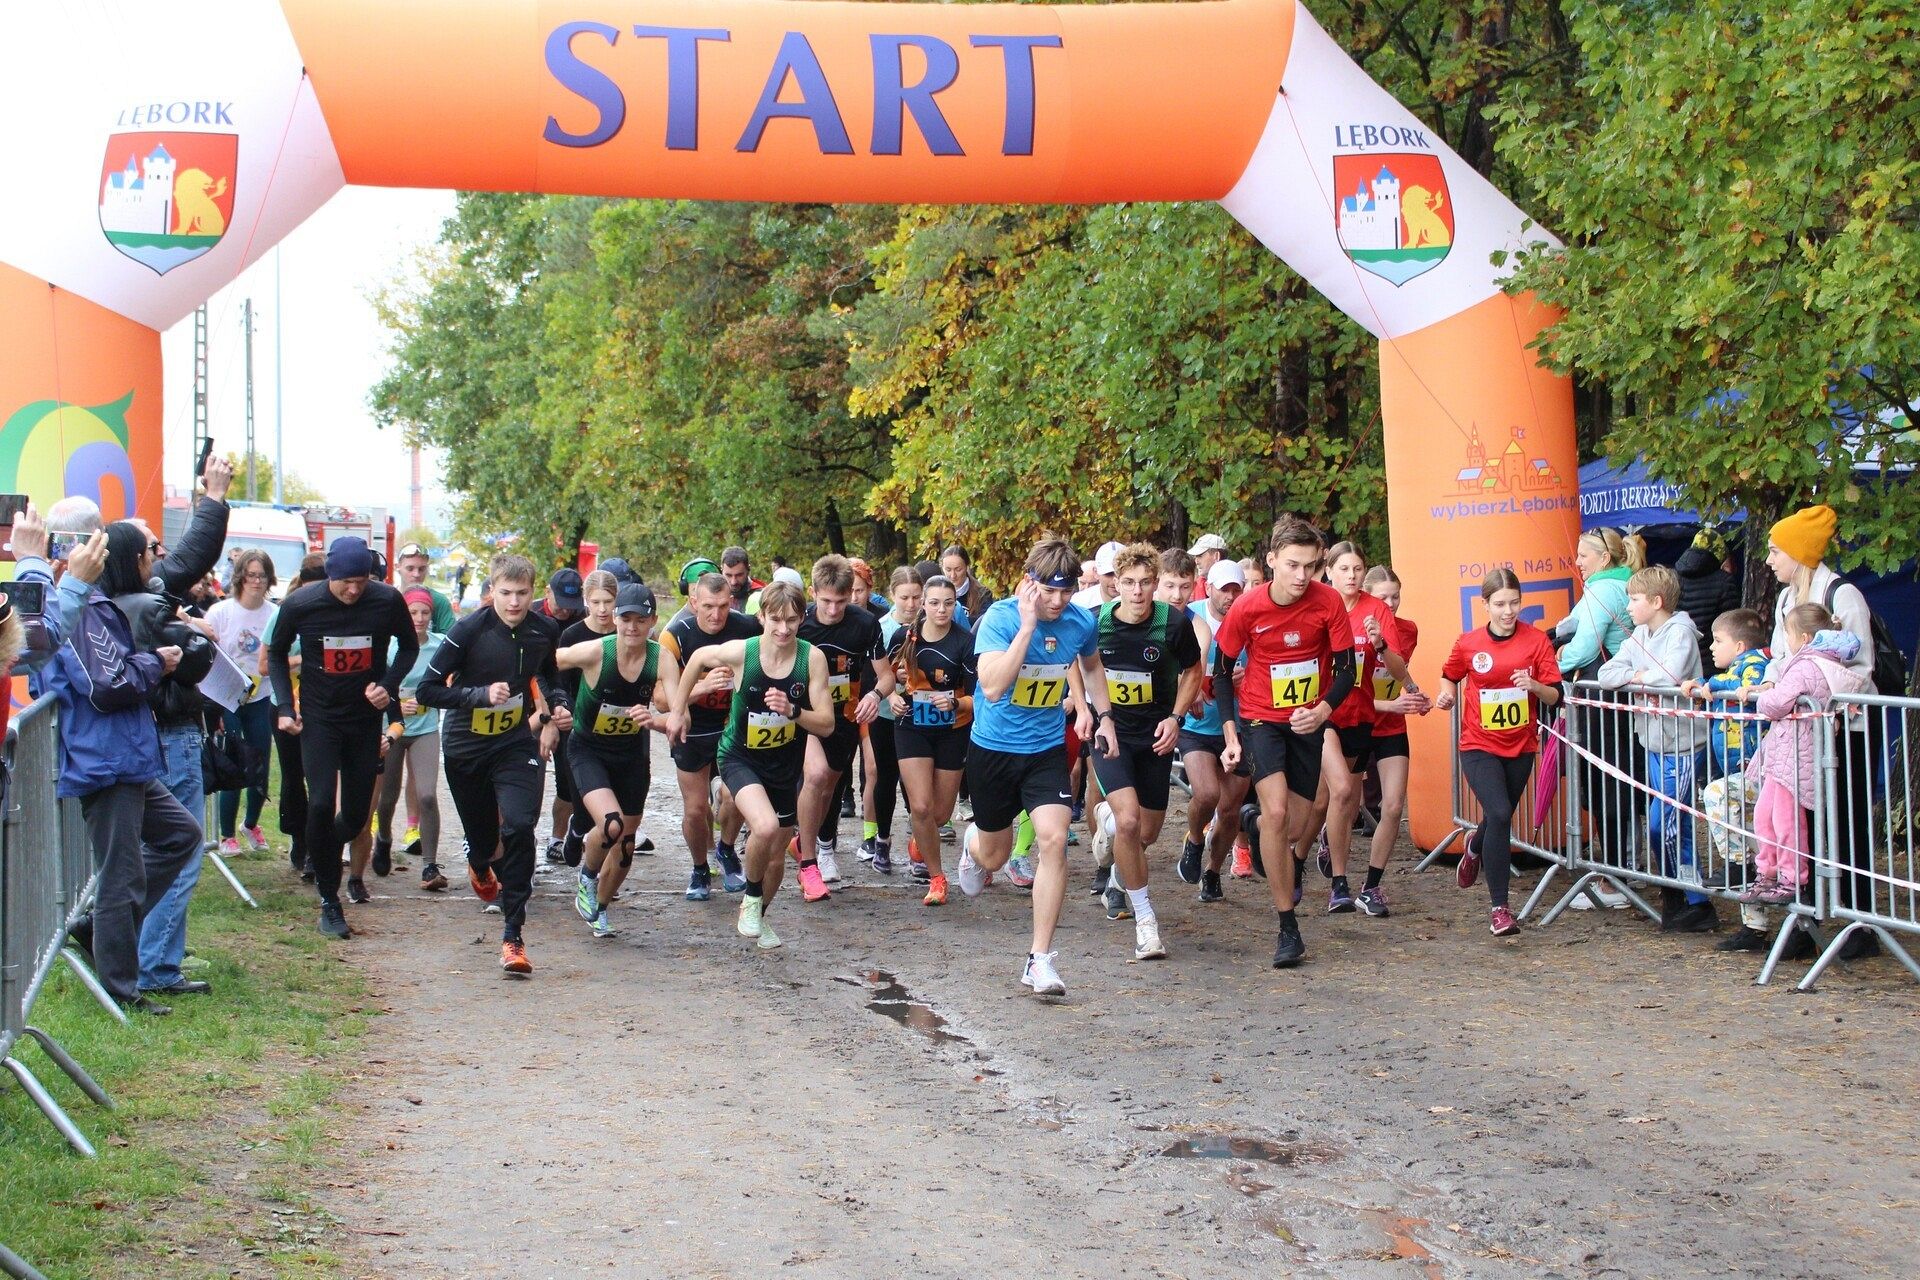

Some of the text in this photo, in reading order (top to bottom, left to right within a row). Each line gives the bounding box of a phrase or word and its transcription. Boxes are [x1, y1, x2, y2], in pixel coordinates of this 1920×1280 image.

[542, 20, 1064, 157] START
[116, 101, 234, 128] LĘBORK
[1335, 124, 1431, 151] LĘBORK
[1613, 488, 1620, 511] I
[1524, 559, 1553, 574] NAS
[335, 650, 363, 672] 82
[1026, 681, 1057, 705] 17
[1116, 683, 1143, 703] 31
[1283, 677, 1312, 704] 47
[485, 711, 514, 733] 15
[604, 717, 634, 734] 35
[1491, 703, 1521, 728] 40
[757, 726, 787, 747] 24
